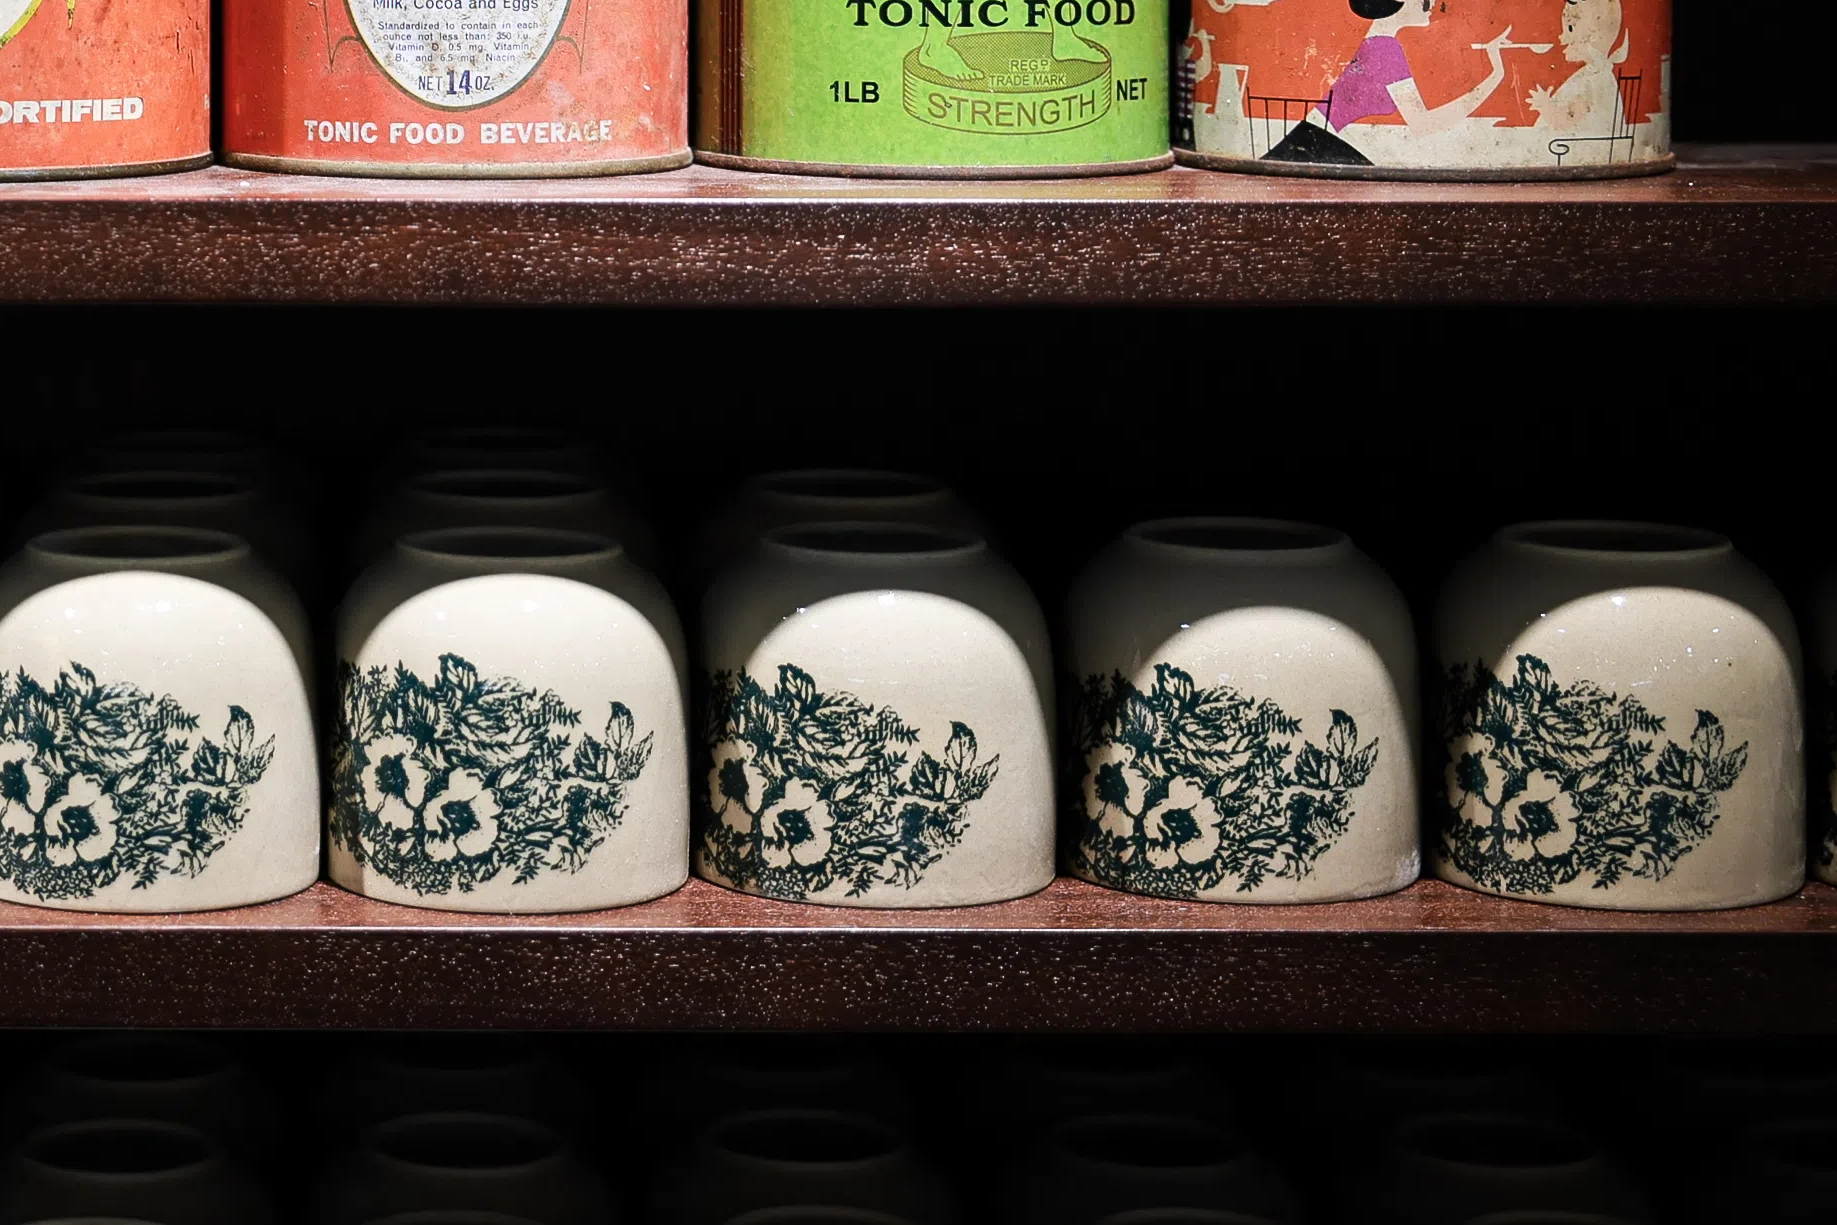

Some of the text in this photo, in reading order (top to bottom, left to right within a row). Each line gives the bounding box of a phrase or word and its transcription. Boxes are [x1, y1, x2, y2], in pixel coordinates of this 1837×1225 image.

[378, 21, 539, 31] Standardized to contain in each
[383, 33, 412, 41] ounce
[418, 32, 434, 41] not
[439, 32, 459, 41] less
[465, 32, 491, 41] than:
[496, 31, 512, 40] 350
[388, 42, 425, 51] Vitamin
[493, 42, 530, 51] Vitamin
[415, 54, 433, 62] and
[485, 53, 516, 62] Niacin
[418, 70, 496, 95] NET 14 OZ.
[989, 74, 1065, 87] TRADE MARK
[1115, 77, 1148, 102] NET
[927, 89, 1096, 127] STRENGTH
[304, 119, 614, 146] TONIC FOOD BEVERAGE
